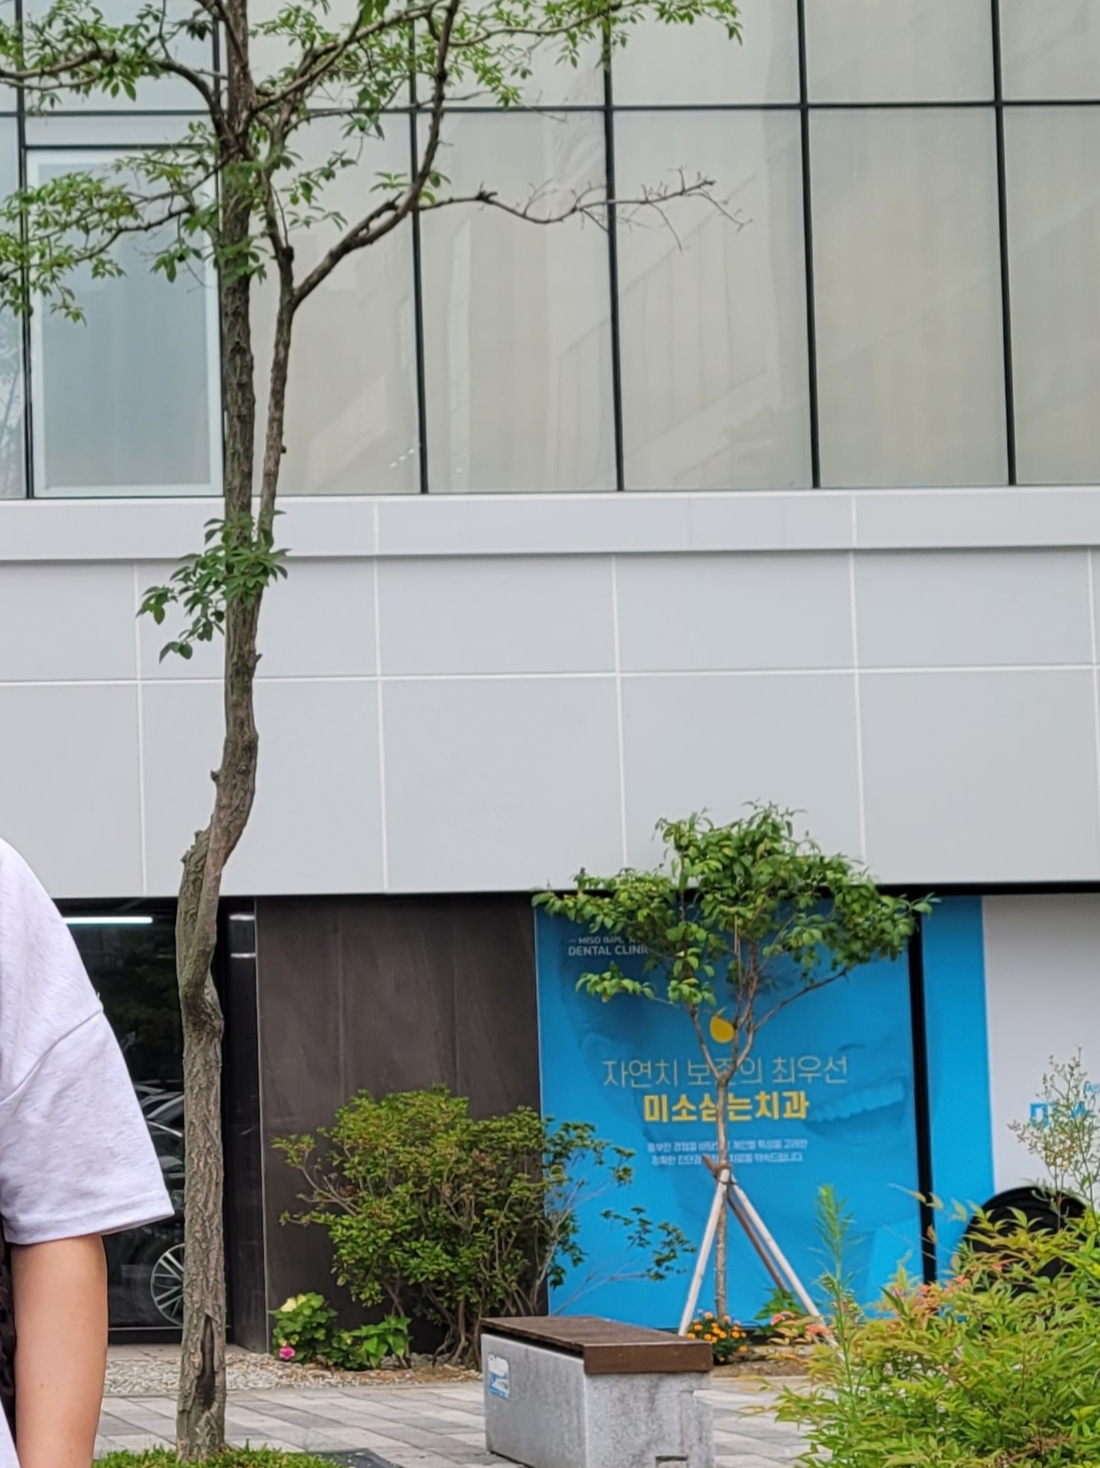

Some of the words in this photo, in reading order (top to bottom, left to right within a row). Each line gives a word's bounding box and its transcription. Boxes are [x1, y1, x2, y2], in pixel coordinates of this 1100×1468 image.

[568, 945, 612, 956] DENTAL
[601, 1058, 678, 1088] 자연치
[772, 1055, 848, 1084] 최우선
